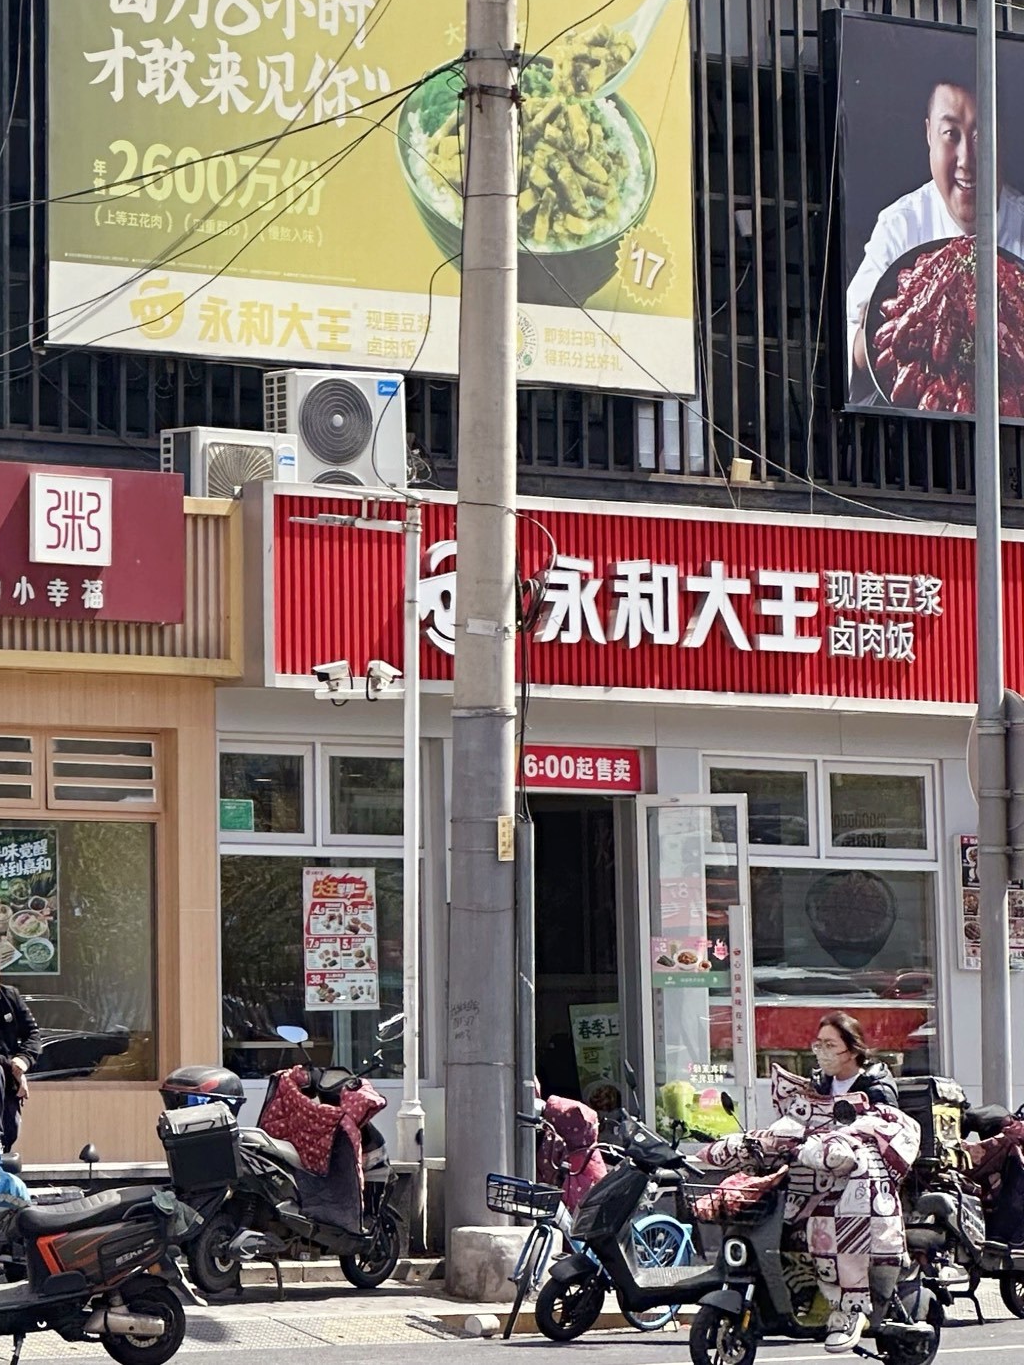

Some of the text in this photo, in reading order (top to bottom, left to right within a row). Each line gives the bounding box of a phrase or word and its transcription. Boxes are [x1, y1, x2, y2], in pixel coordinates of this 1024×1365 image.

[197, 295, 352, 353] 永和大王
[534, 555, 821, 653] 永和大王
[825, 570, 942, 617] 现磨豆浆
[827, 618, 916, 663] 卤肉饭
[524, 754, 631, 783] 6:00起售卖
